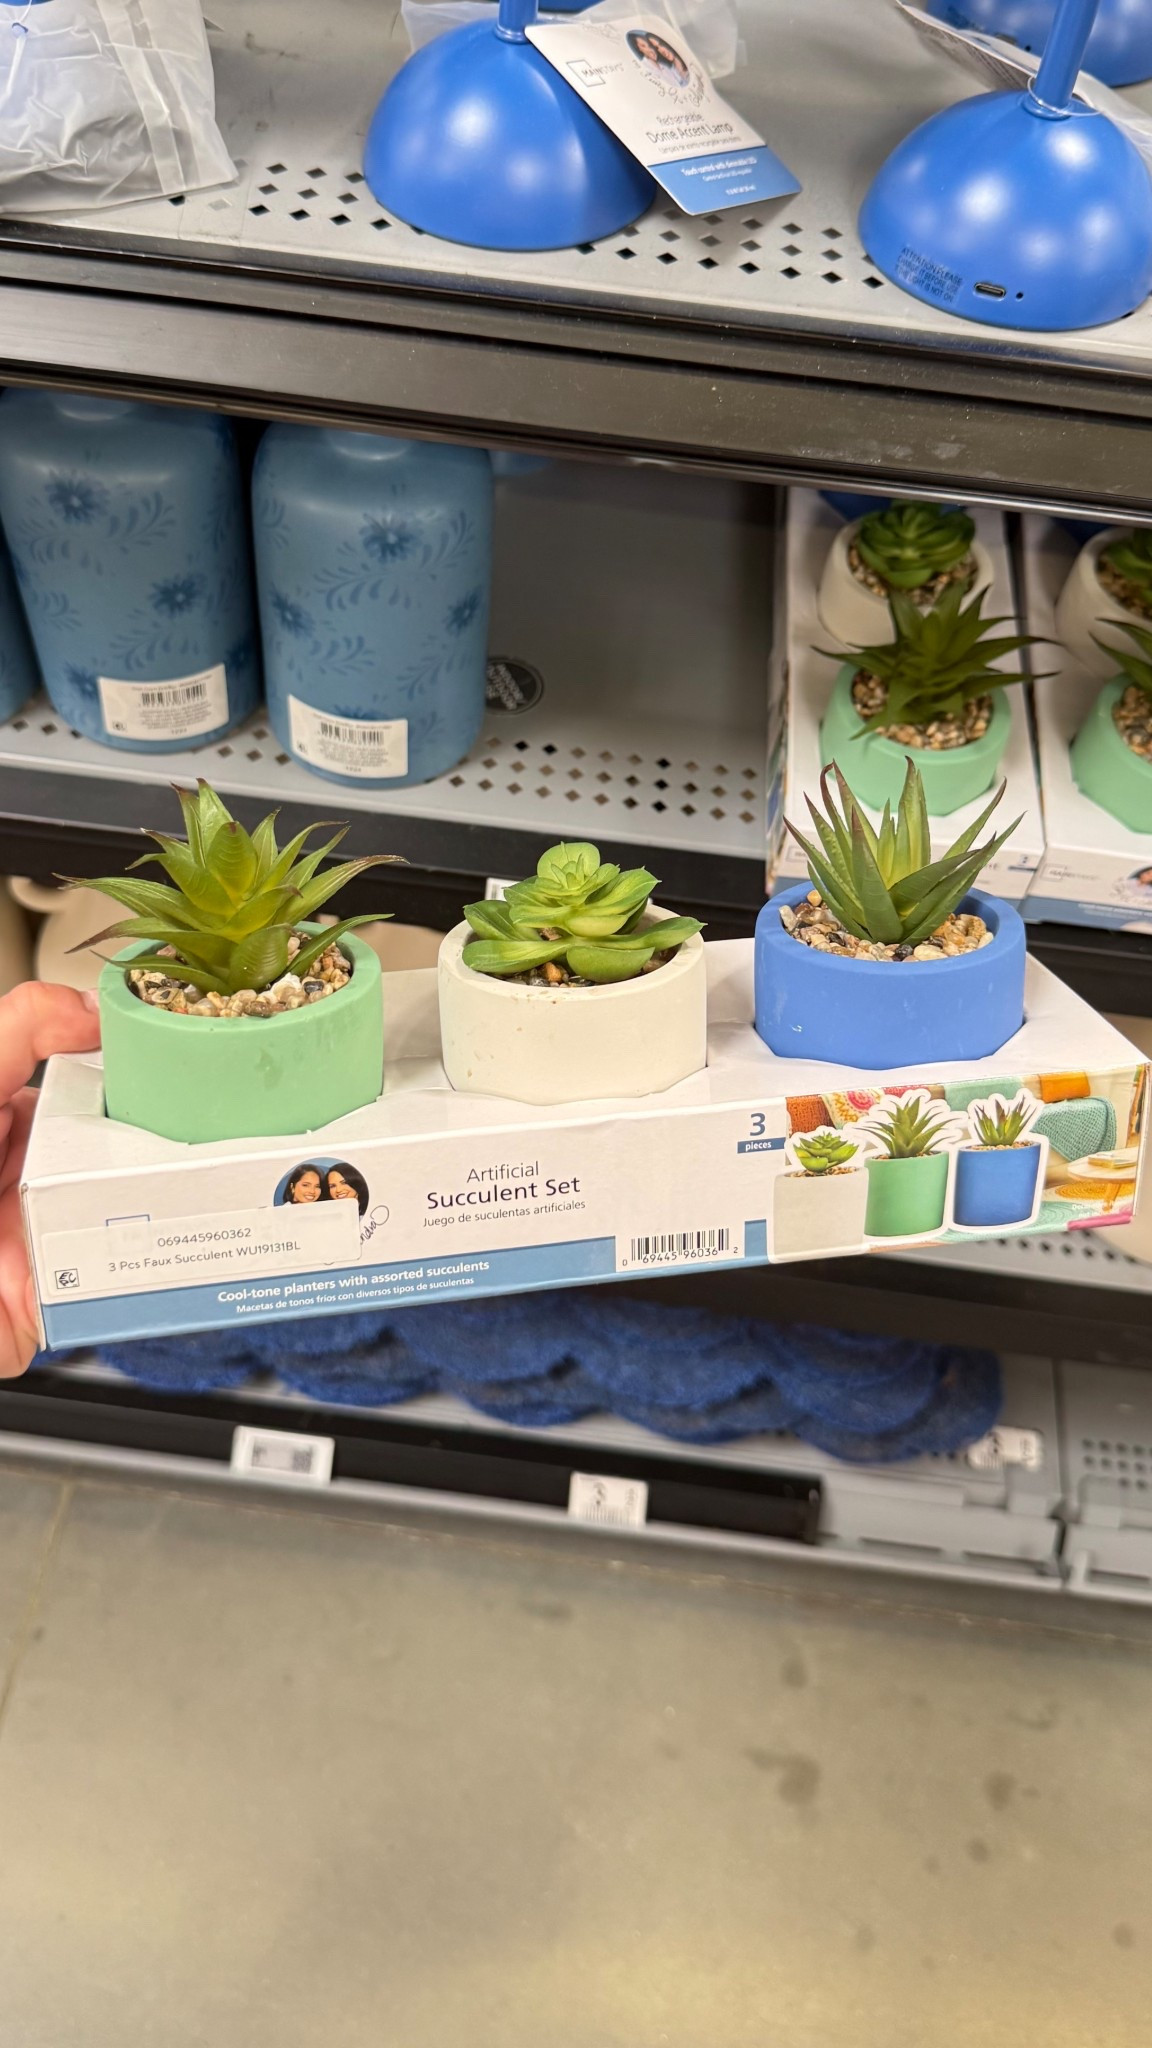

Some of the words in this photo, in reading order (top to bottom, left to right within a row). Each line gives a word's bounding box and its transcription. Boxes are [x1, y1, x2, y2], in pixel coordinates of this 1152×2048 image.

[646, 129, 679, 144] Dome
[678, 124, 709, 140] Accent
[705, 122, 734, 136] Lamp
[900, 248, 937, 272] ATTENTION
[936, 267, 962, 286] PLEASE
[750, 1112, 766, 1136] 3
[745, 1139, 772, 1152] pieces
[466, 1160, 540, 1183] Artificial
[427, 1183, 538, 1210] Succulent
[546, 1176, 580, 1197] Set
[423, 1215, 455, 1228] Juego
[458, 1212, 472, 1224] de
[475, 1206, 530, 1222] suculentas
[534, 1200, 586, 1216] artificiales
[157, 1227, 252, 1248] 069445960362
[108, 1262, 116, 1272] 3
[120, 1258, 141, 1272] Pcs
[144, 1254, 172, 1268] Faux
[175, 1248, 234, 1266] Succulent
[236, 1240, 301, 1257] WU19131BL
[642, 1251, 678, 1264] 69445
[683, 1246, 719, 1259] 96036
[218, 1284, 282, 1302] Cool-tone
[284, 1278, 336, 1297] planters
[338, 1274, 368, 1288] with
[371, 1266, 424, 1284] assorted
[426, 1259, 490, 1277] succulents
[236, 1301, 273, 1314] Macetas
[276, 1298, 287, 1309] de
[289, 1297, 314, 1308] tonos
[316, 1292, 336, 1306] fríos
[338, 1292, 354, 1302] con
[356, 1286, 390, 1300] diversos
[392, 1282, 414, 1296] tipos
[416, 1281, 428, 1292] de
[430, 1276, 474, 1290] suculentas
